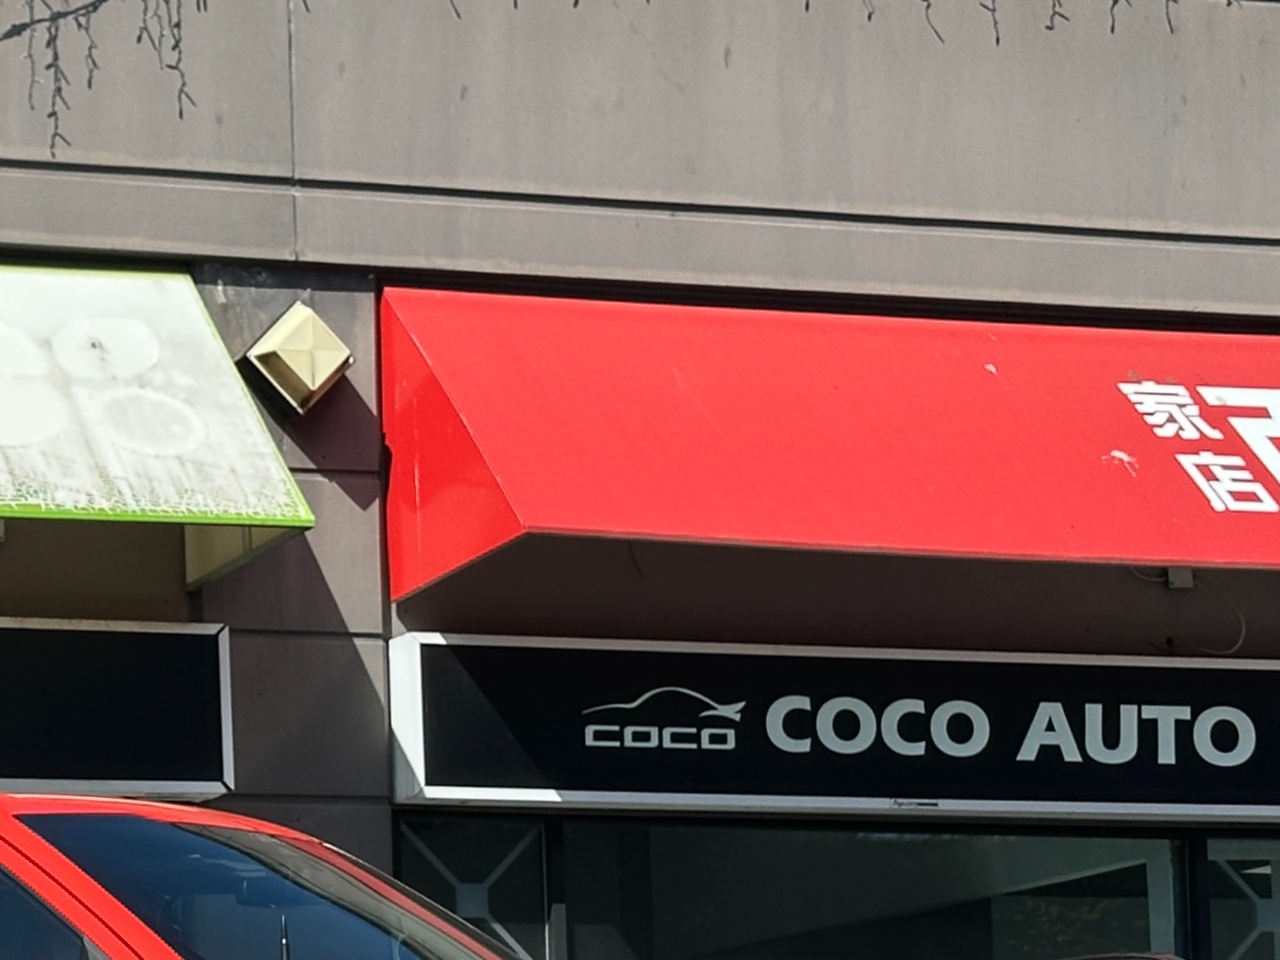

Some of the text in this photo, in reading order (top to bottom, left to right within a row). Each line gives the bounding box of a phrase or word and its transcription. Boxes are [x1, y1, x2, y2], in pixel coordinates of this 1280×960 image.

[585, 725, 737, 751] COCO
[766, 695, 1257, 767] COCO AUTO
